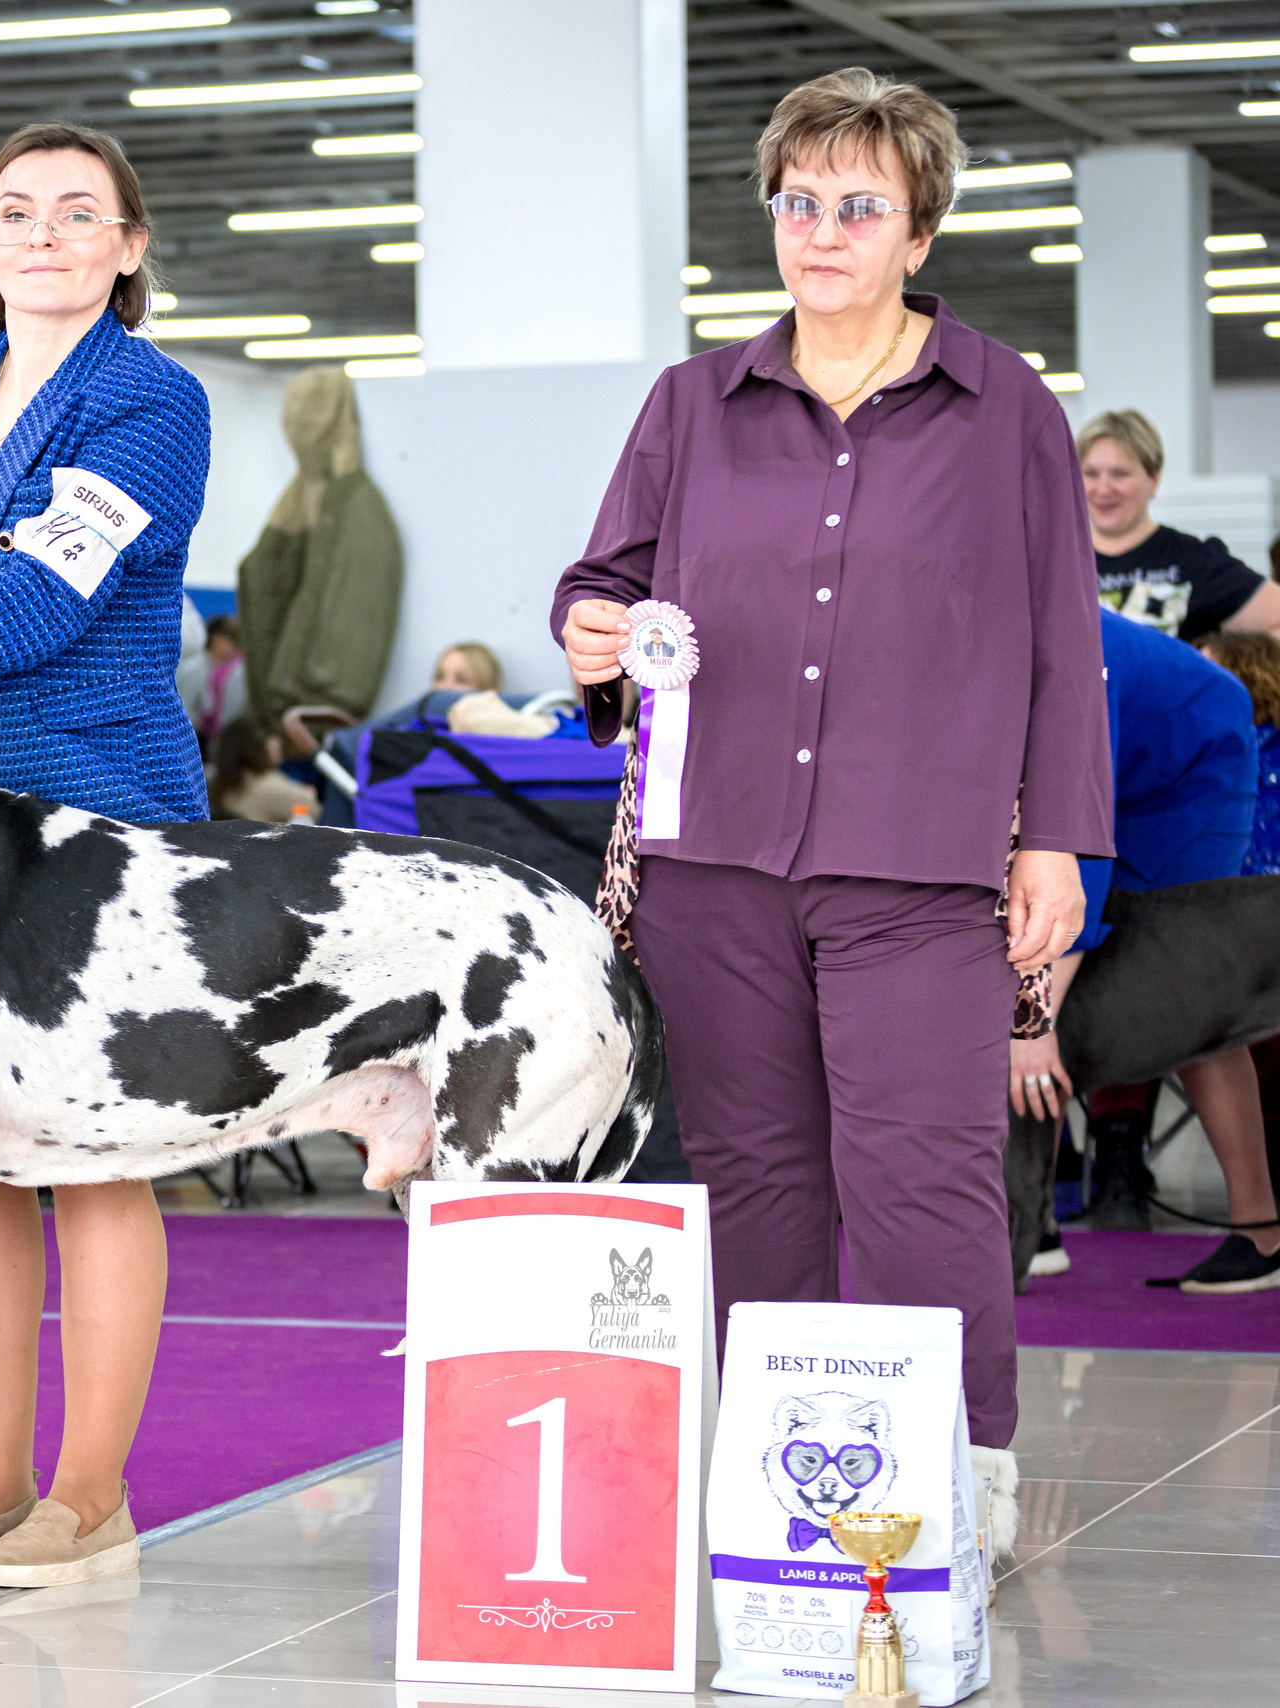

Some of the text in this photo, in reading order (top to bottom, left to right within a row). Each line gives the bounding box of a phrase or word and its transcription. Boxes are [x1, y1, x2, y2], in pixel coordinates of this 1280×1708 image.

[73, 486, 125, 527] SIRIUS
[589, 1304, 640, 1332] Yuliya
[588, 1328, 677, 1349] Germanika
[766, 1355, 818, 1373] BEST
[506, 1397, 587, 1584] 1
[779, 1568, 866, 1584] LAMB & APPL
[746, 1592, 767, 1602] 70%
[779, 1595, 794, 1604] 0%
[809, 1597, 825, 1607] 0%
[782, 1668, 855, 1681] SENSIBLE AD
[817, 1681, 843, 1689] MAXI
